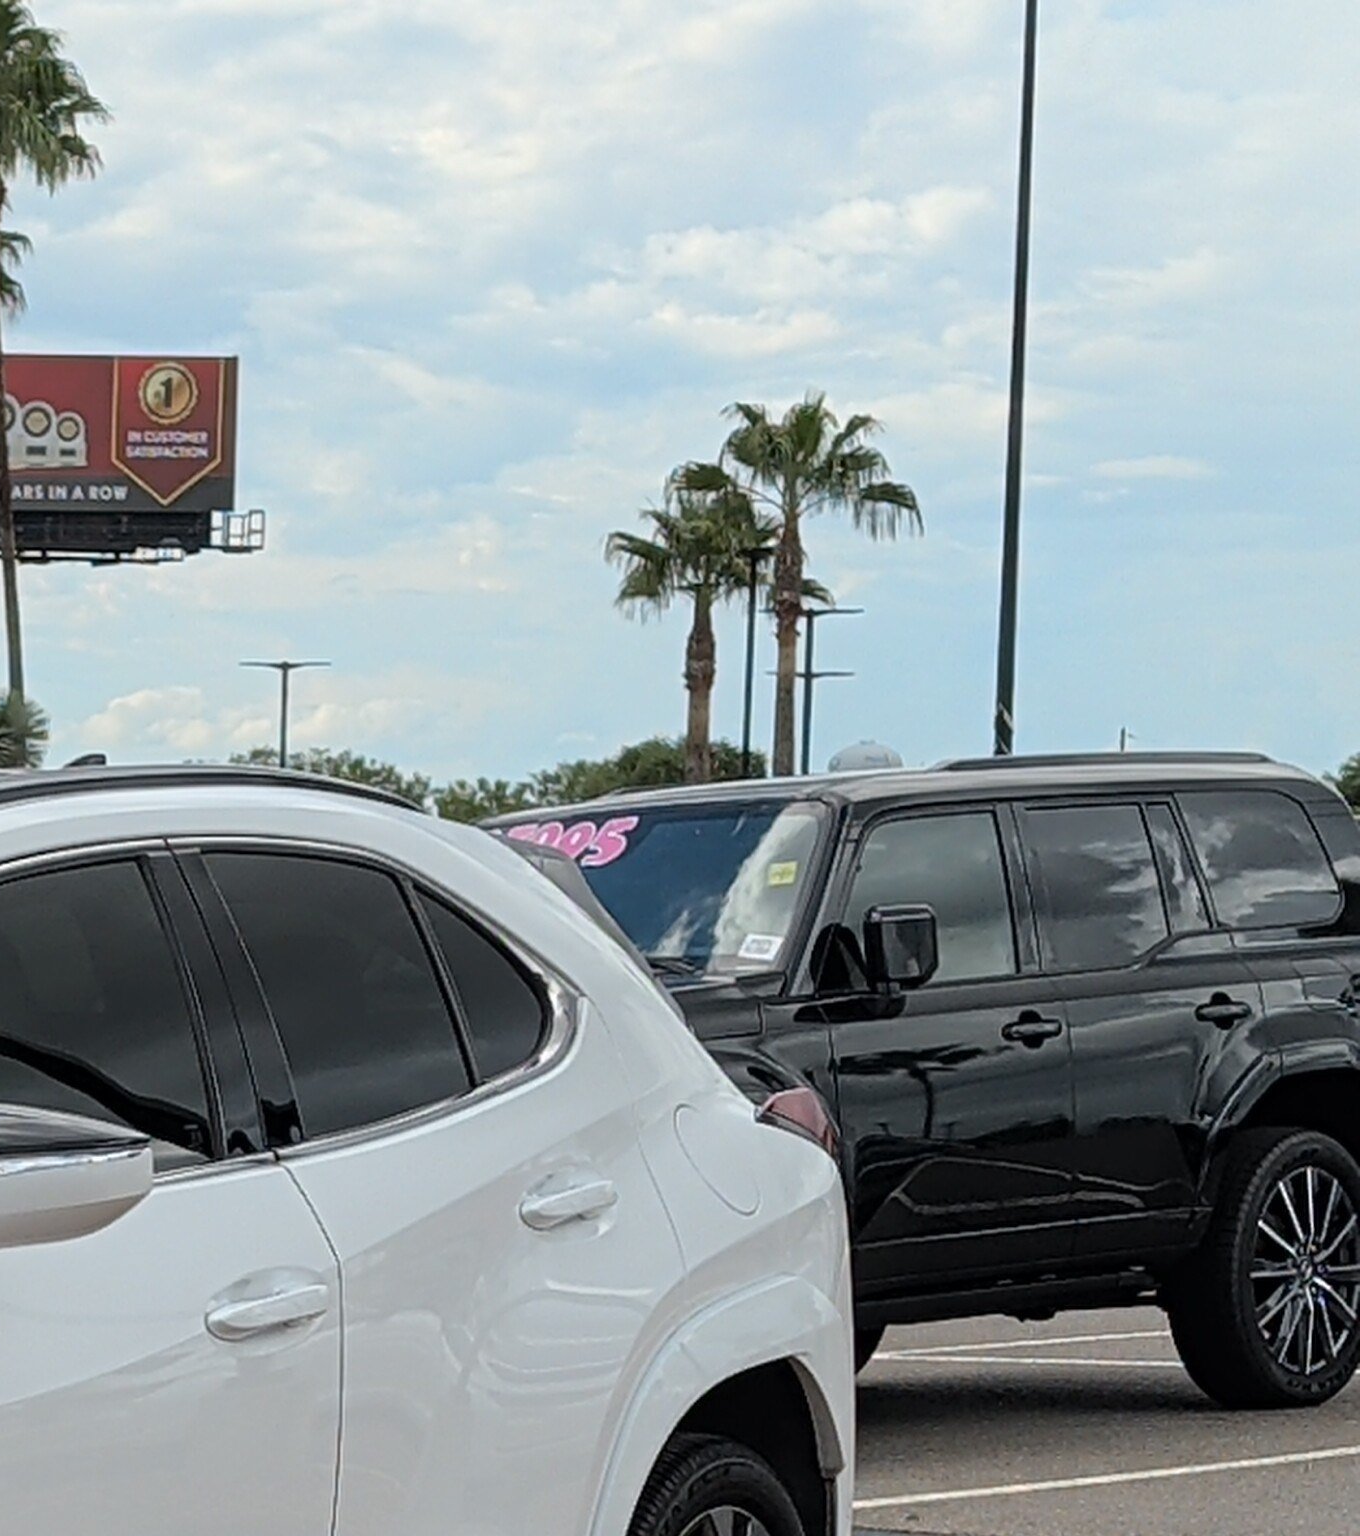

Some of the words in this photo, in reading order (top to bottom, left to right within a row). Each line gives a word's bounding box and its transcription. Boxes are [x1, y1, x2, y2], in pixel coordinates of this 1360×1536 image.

[48, 485, 67, 500] IN
[71, 485, 85, 500] A
[88, 486, 129, 500] ROW
